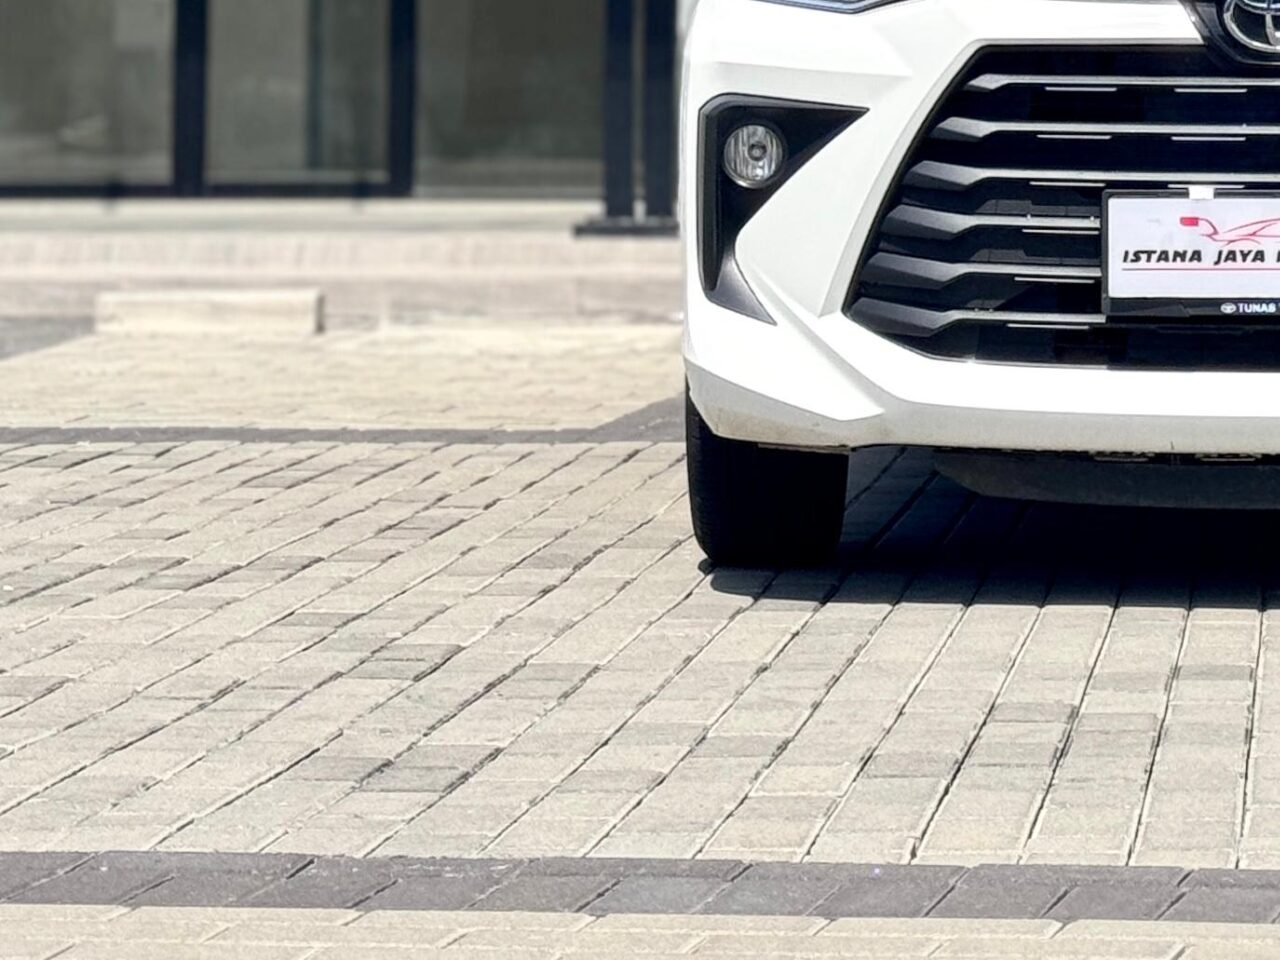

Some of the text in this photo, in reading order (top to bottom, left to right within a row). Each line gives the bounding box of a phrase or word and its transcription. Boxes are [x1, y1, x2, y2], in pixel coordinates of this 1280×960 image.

[1122, 249, 1202, 263] ISTANA
[1214, 249, 1266, 265] JAYA
[1237, 303, 1276, 314] TUNAS
